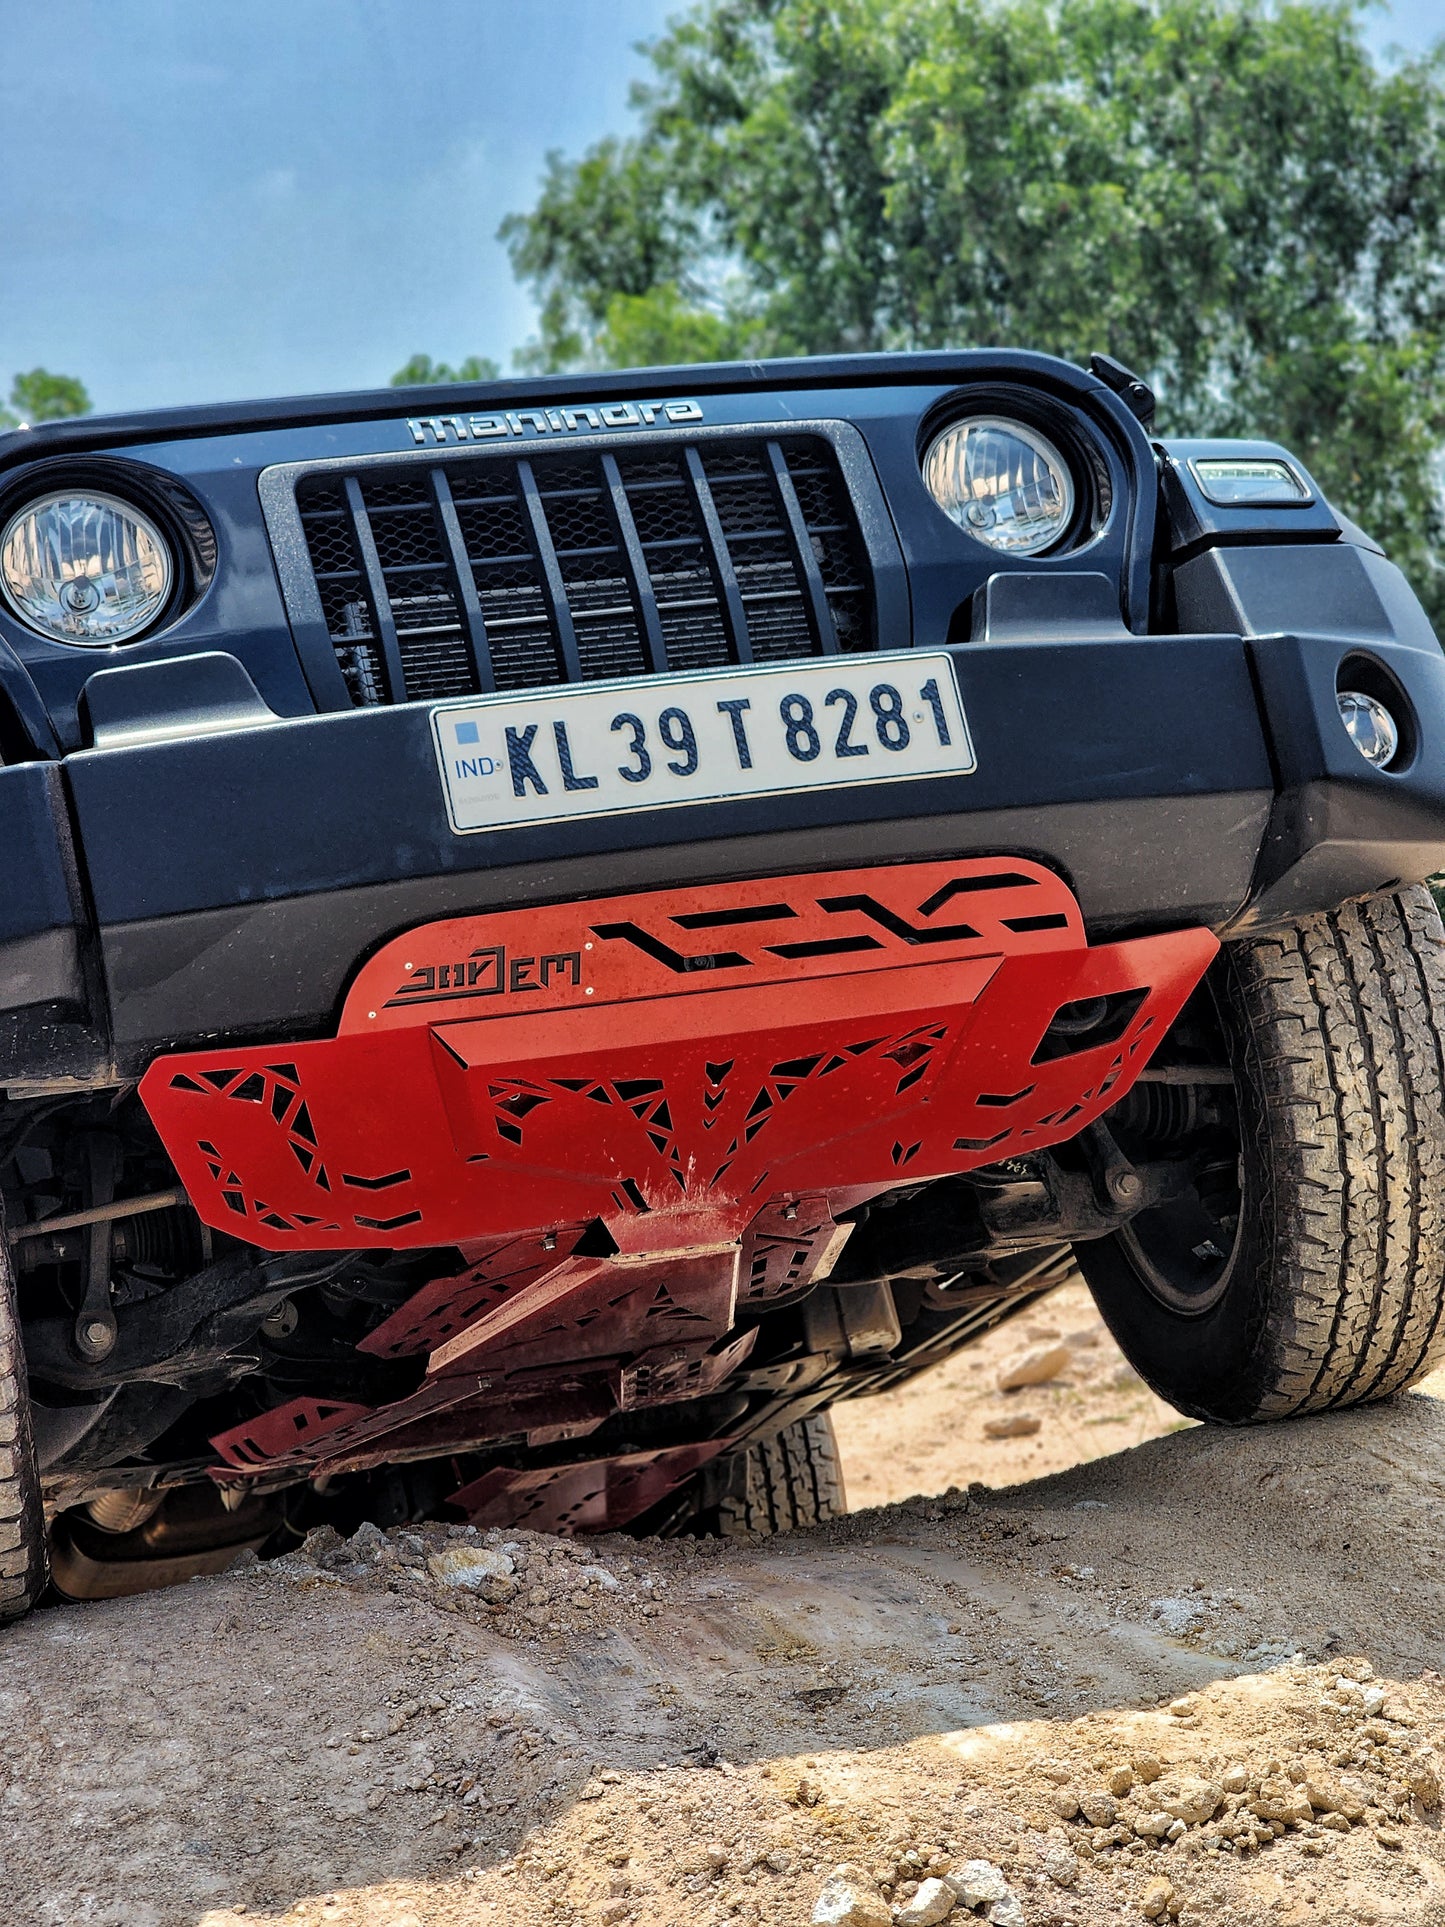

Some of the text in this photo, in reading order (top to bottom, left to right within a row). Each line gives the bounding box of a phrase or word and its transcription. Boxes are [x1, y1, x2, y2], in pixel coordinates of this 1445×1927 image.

[406, 399, 704, 444] mahindra
[504, 678, 952, 797] KL 39 T 8281
[455, 757, 494, 779] IND
